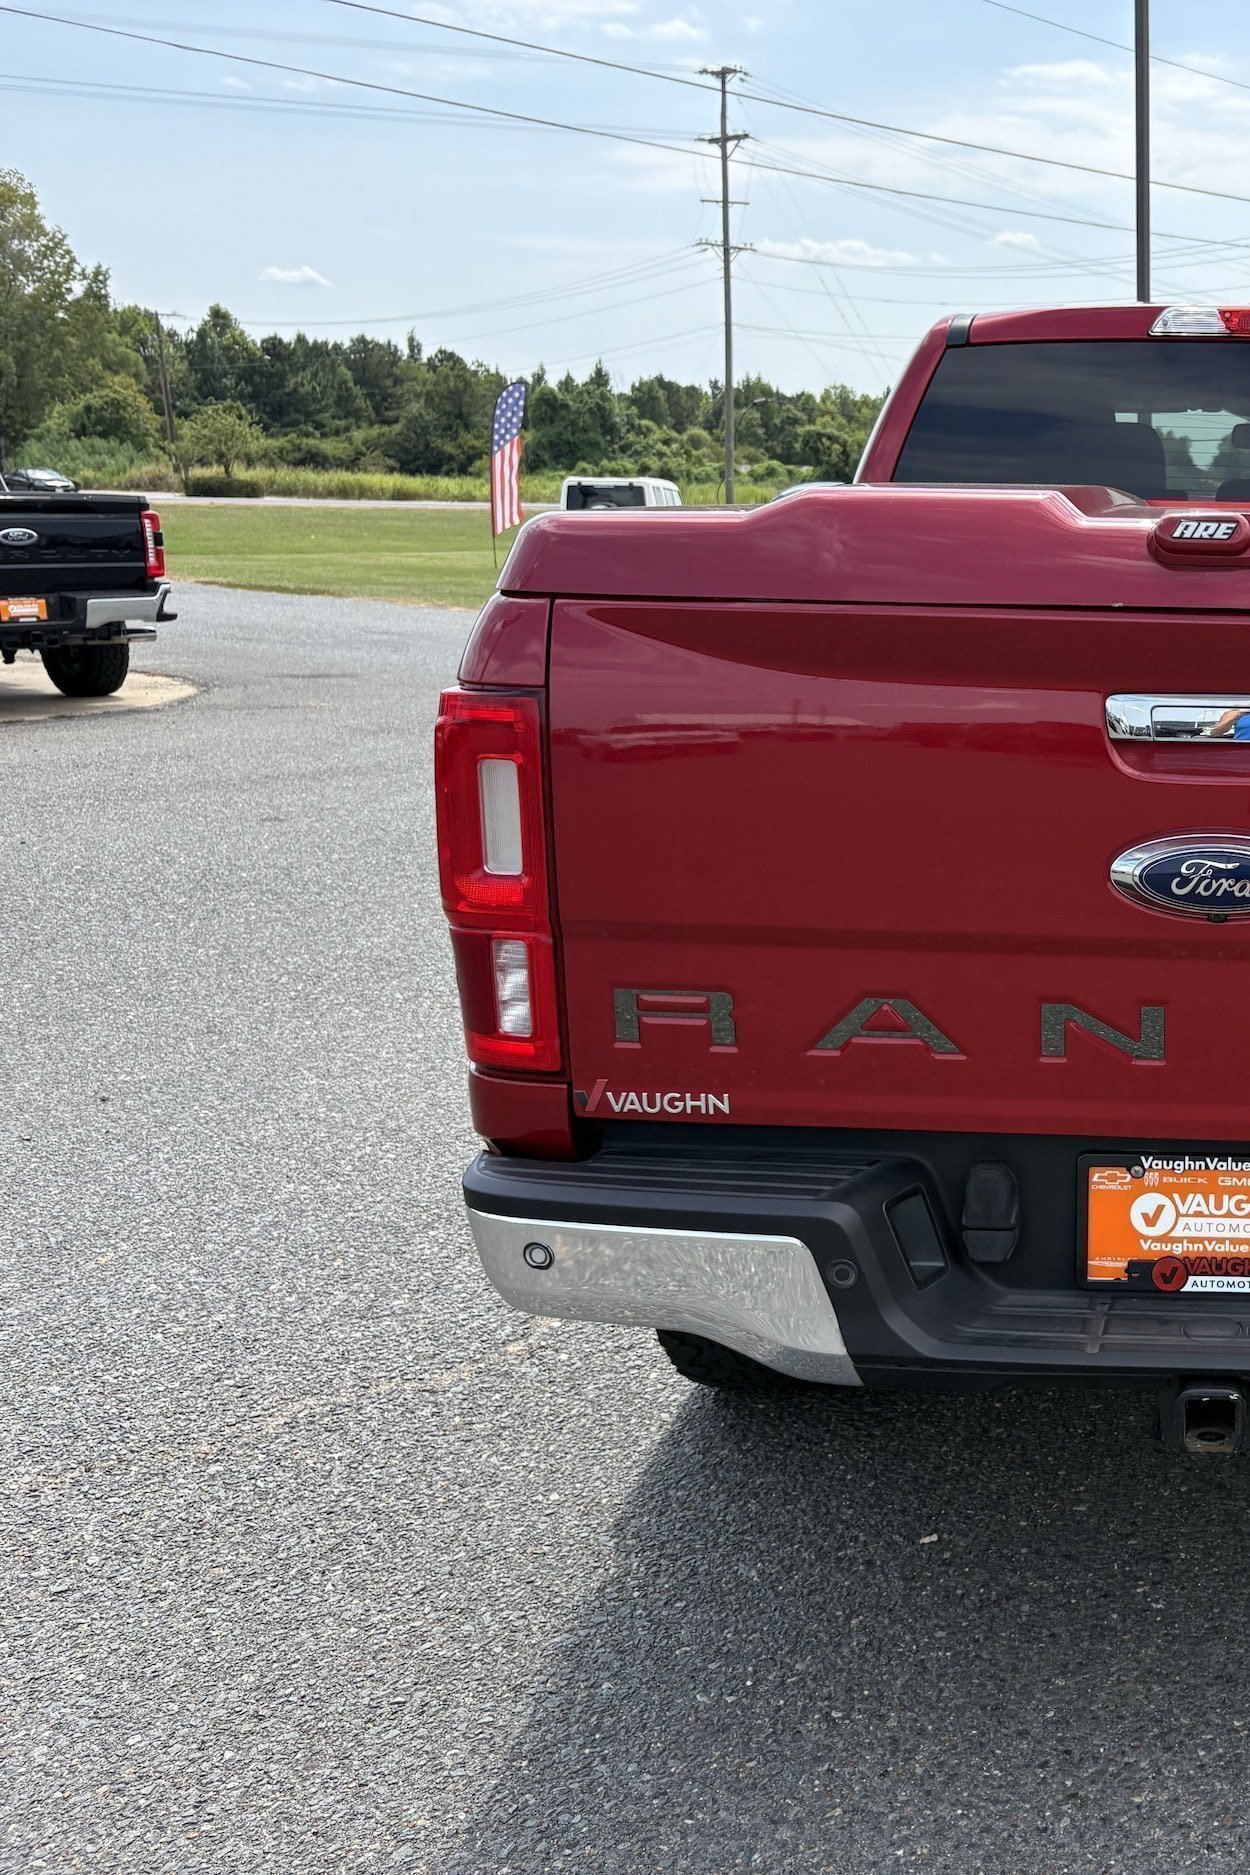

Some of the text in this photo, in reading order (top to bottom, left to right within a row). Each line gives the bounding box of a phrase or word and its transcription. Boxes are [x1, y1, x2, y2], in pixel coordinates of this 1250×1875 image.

[1171, 519, 1239, 541] ARE
[606, 1091, 731, 1115] VAUGHN
[1163, 1176, 1208, 1185] BUICK
